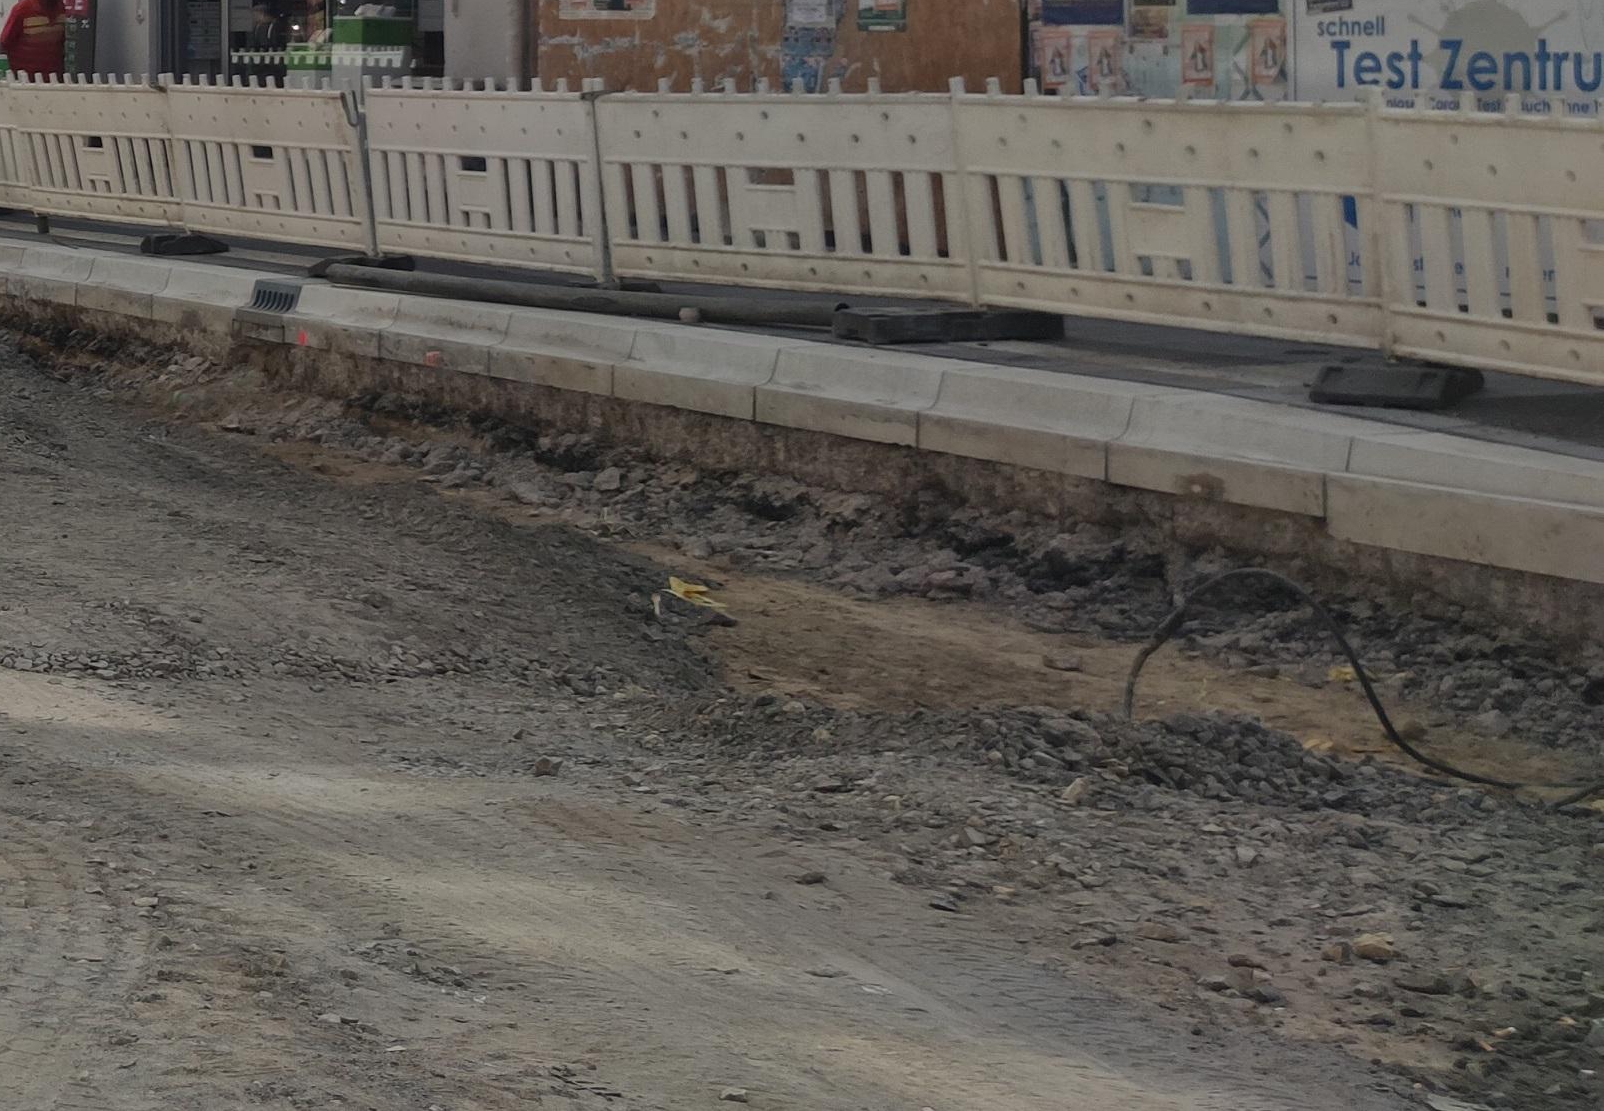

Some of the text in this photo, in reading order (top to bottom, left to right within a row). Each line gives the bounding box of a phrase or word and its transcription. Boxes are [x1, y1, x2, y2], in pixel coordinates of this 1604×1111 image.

[1316, 16, 1385, 37] schnell
[1330, 38, 1604, 92] Test Zentru
